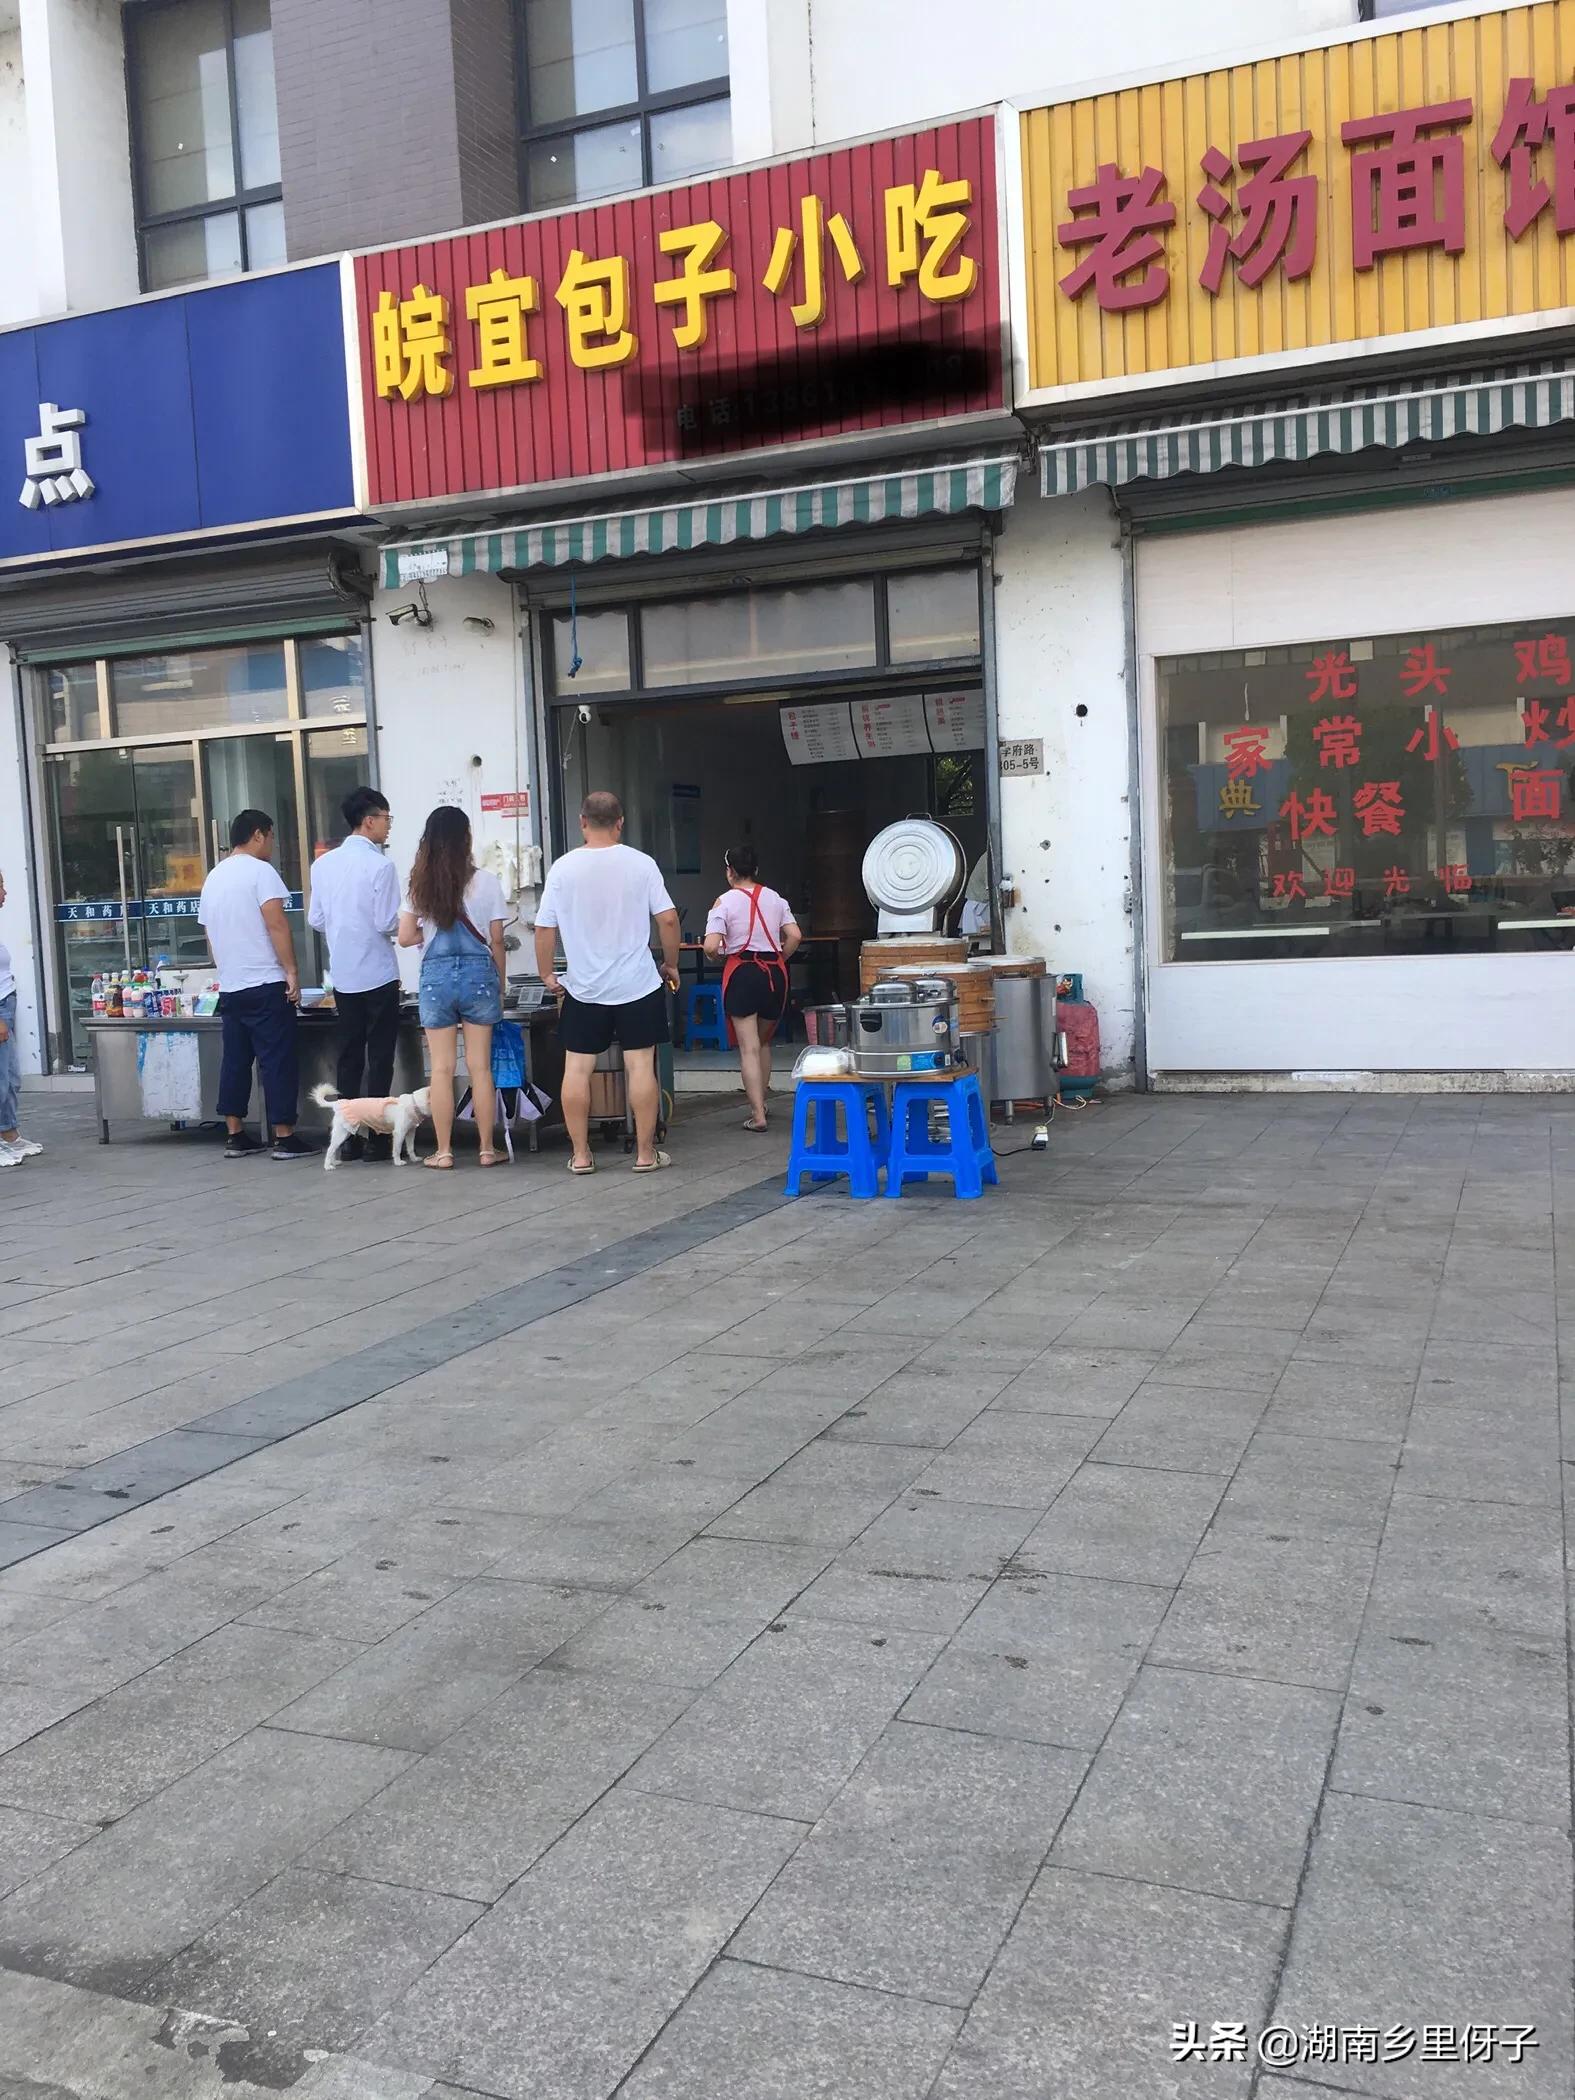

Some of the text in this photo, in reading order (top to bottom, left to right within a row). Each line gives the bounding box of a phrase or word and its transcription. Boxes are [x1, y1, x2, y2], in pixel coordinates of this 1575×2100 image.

[372, 169, 977, 402] 皖宜包子小吃
[18, 402, 96, 510] 点
[1280, 781, 1406, 841] 快餐
[1511, 769, 1565, 822] 面
[1272, 864, 1473, 900] 欢迎光临
